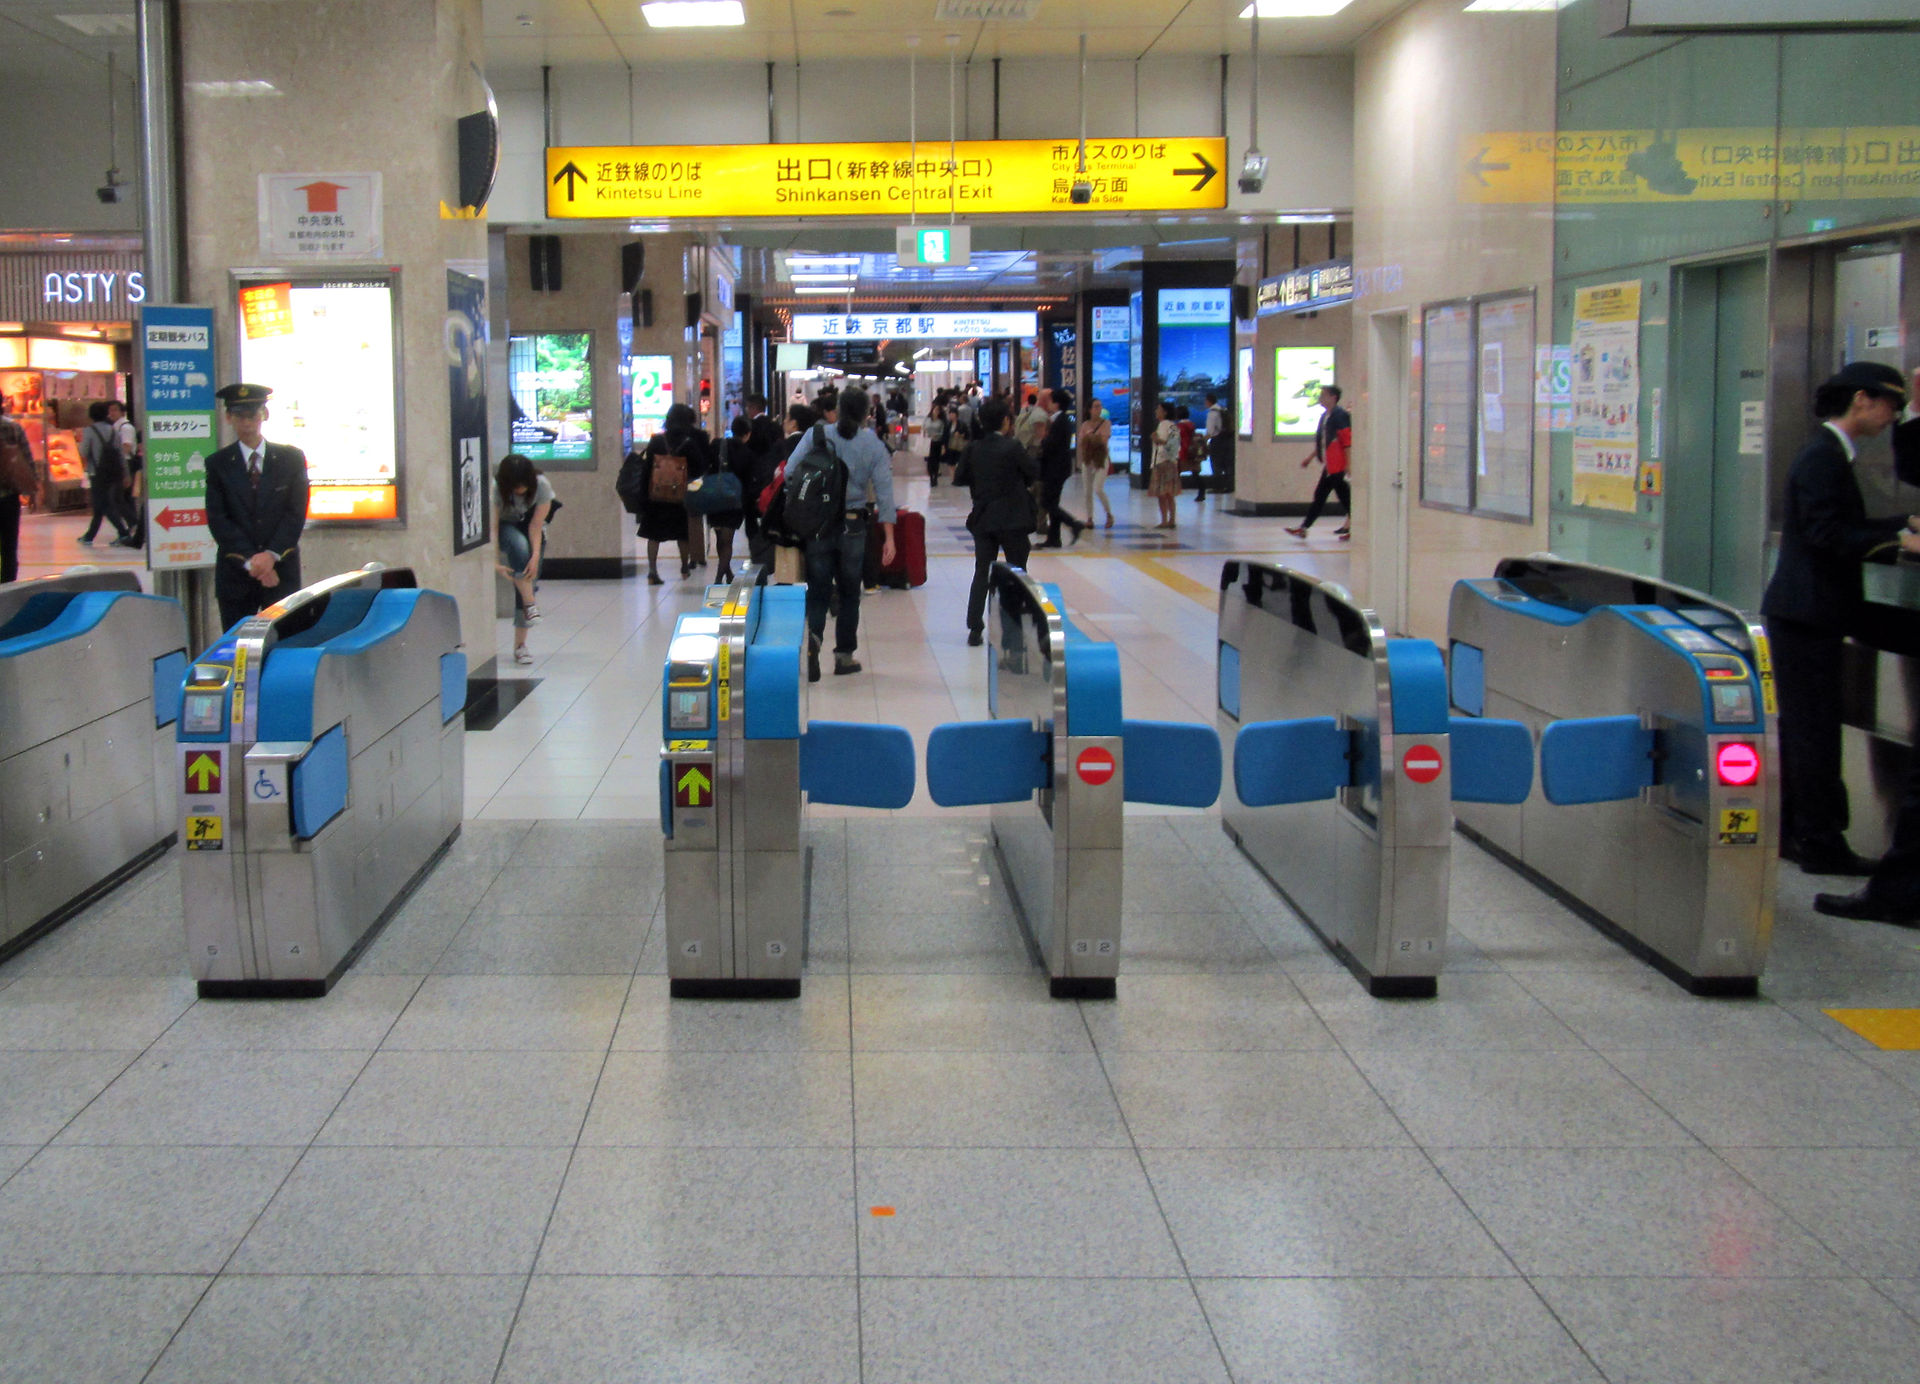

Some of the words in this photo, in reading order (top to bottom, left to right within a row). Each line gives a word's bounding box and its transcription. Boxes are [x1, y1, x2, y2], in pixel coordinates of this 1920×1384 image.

[597, 161, 702, 182] 近鉄線のりば
[1097, 162, 1137, 170] Terminal
[1052, 176, 1128, 193] 烏方面
[597, 187, 662, 199] Kintetsu
[669, 187, 702, 199] Line
[776, 187, 881, 202] Shinkansen
[888, 185, 953, 200] Central
[960, 184, 993, 199] Exit
[1103, 194, 1124, 203] Side
[44, 272, 116, 303] ASTY
[148, 331, 206, 342] 定期観光バス
[151, 361, 195, 371] 本日分から
[153, 421, 208, 432] 観光タクシー
[154, 452, 180, 462] 今から
[173, 512, 200, 523] こちら
[207, 945, 218, 955] 5
[289, 945, 300, 954] 4
[687, 944, 697, 954] 4
[770, 943, 781, 953] 3
[1076, 942, 1087, 953] 3
[1099, 942, 1110, 953] 2
[1400, 941, 1411, 951] 2
[1427, 940, 1433, 951] 1
